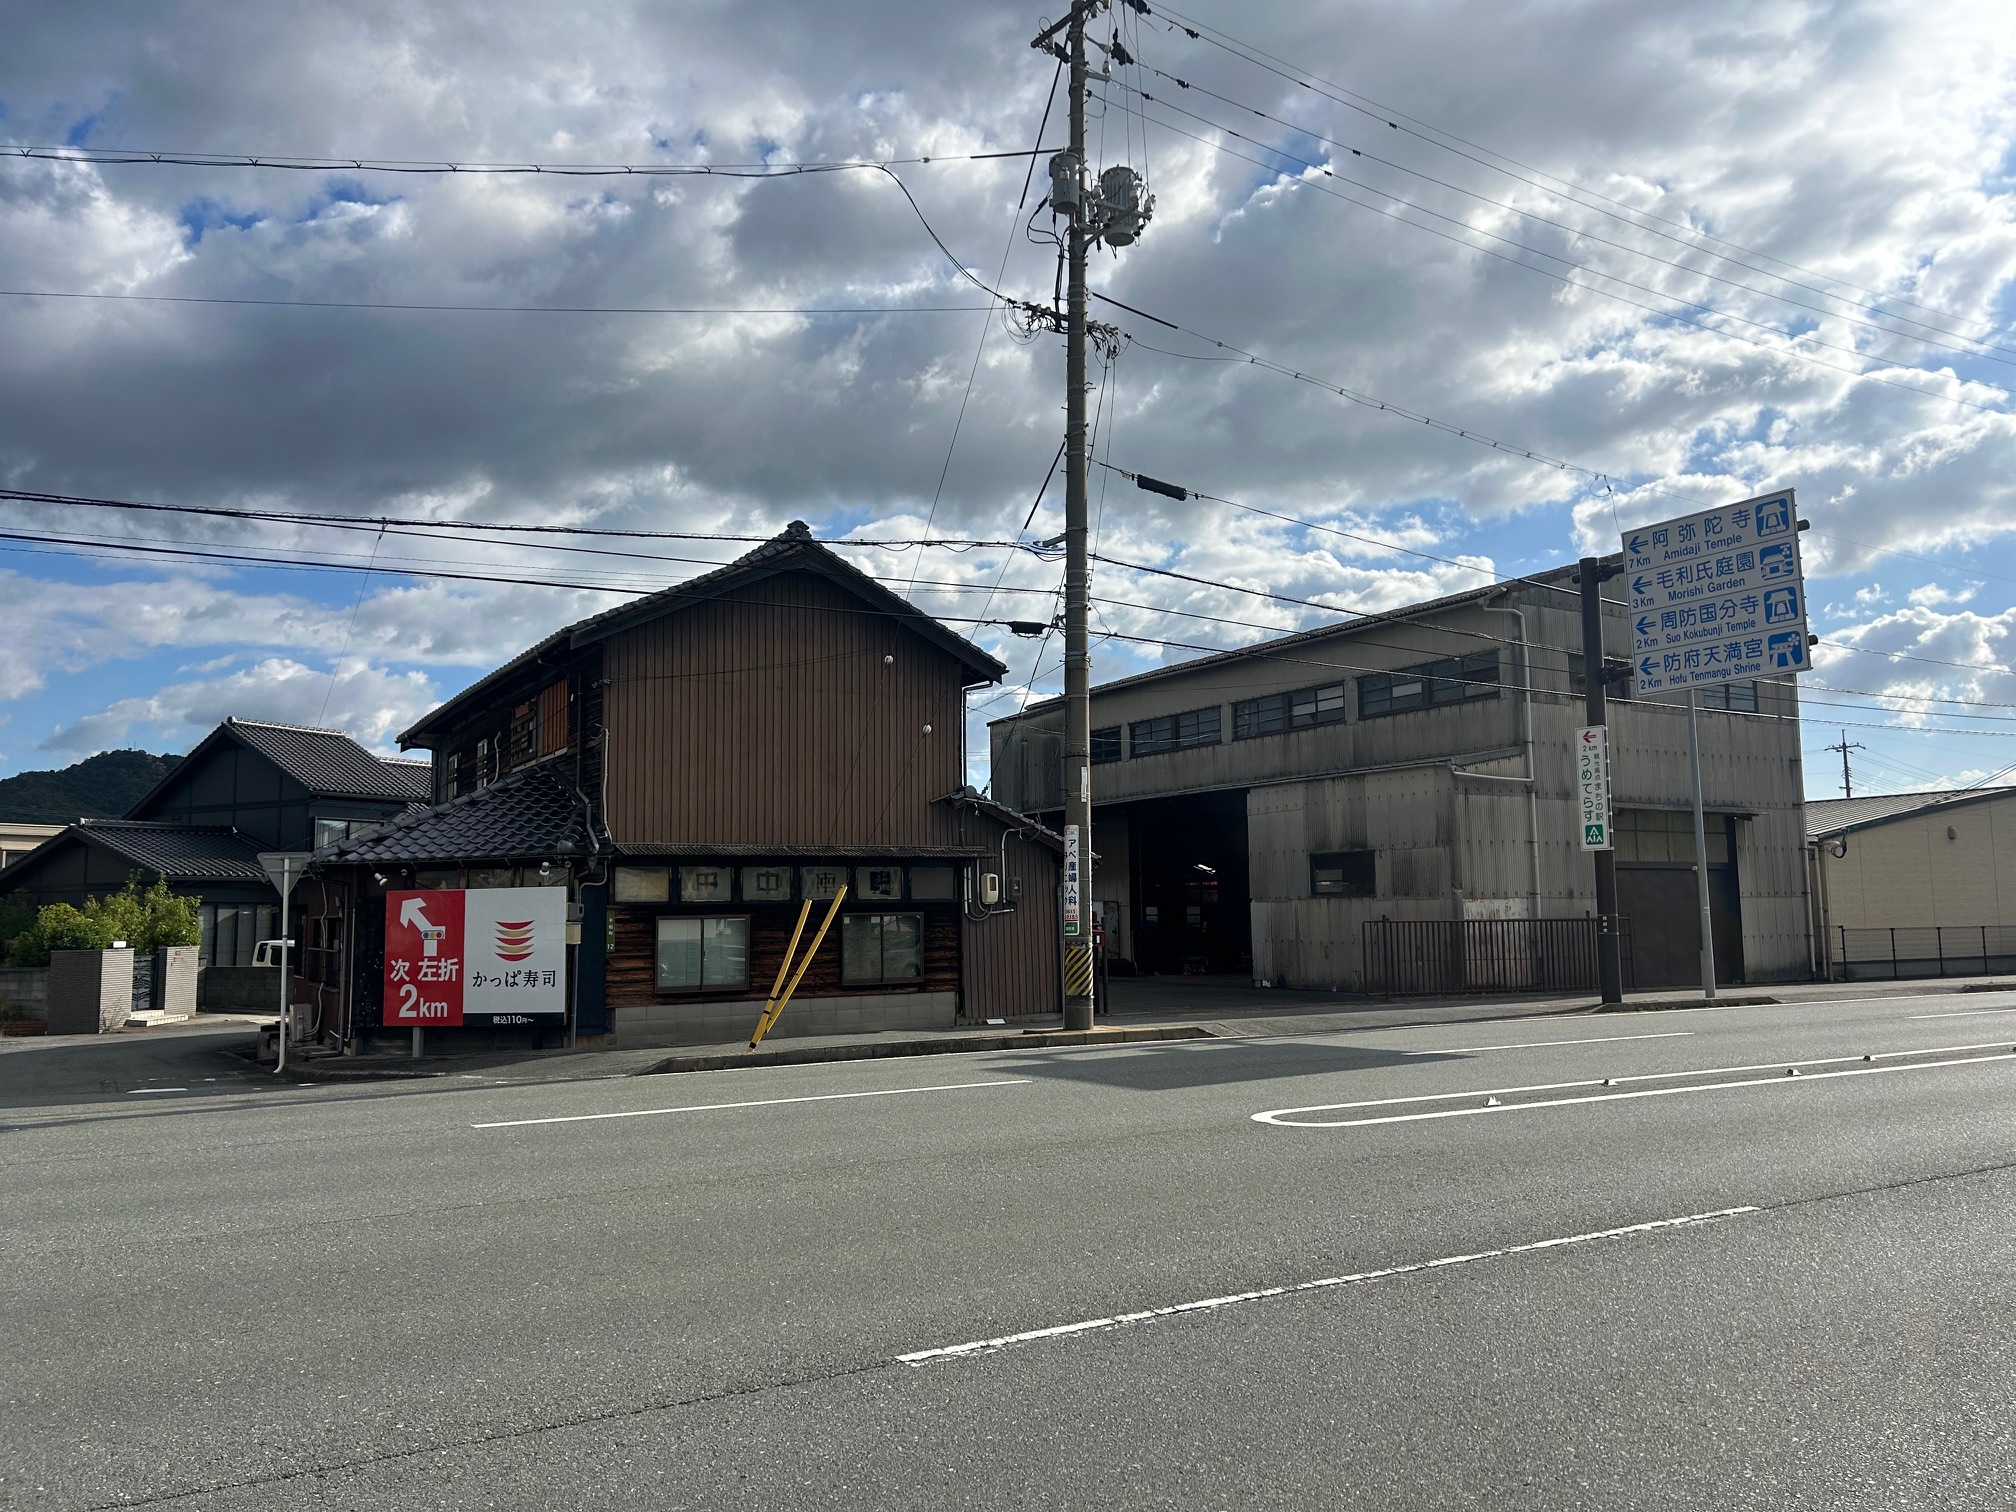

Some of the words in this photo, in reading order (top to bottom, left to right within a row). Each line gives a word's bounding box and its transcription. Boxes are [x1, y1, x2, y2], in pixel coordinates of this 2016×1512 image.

[1652, 508, 1751, 549] 阿弥陀寺
[1663, 542, 1701, 561] Amidaji
[1704, 533, 1742, 550] Temple
[1656, 551, 1755, 589] 毛利氏庭園
[1668, 584, 1704, 601] Morishi
[1708, 577, 1745, 593] Garden
[1660, 594, 1759, 632] 周防国分寺
[1666, 633, 1681, 644] Suo
[1683, 623, 1723, 640] Kokubunji
[1725, 618, 1756, 632] Temple
[1663, 638, 1763, 673] 防府天満宮
[1669, 674, 1687, 685] Hofu
[1690, 666, 1731, 680] Tenmangu
[1734, 662, 1761, 675] Shrine
[1580, 755, 1594, 822] うめてらす
[390, 958, 410, 982] 次
[417, 957, 460, 982] 左折
[472, 969, 556, 988] かっぱ寿司
